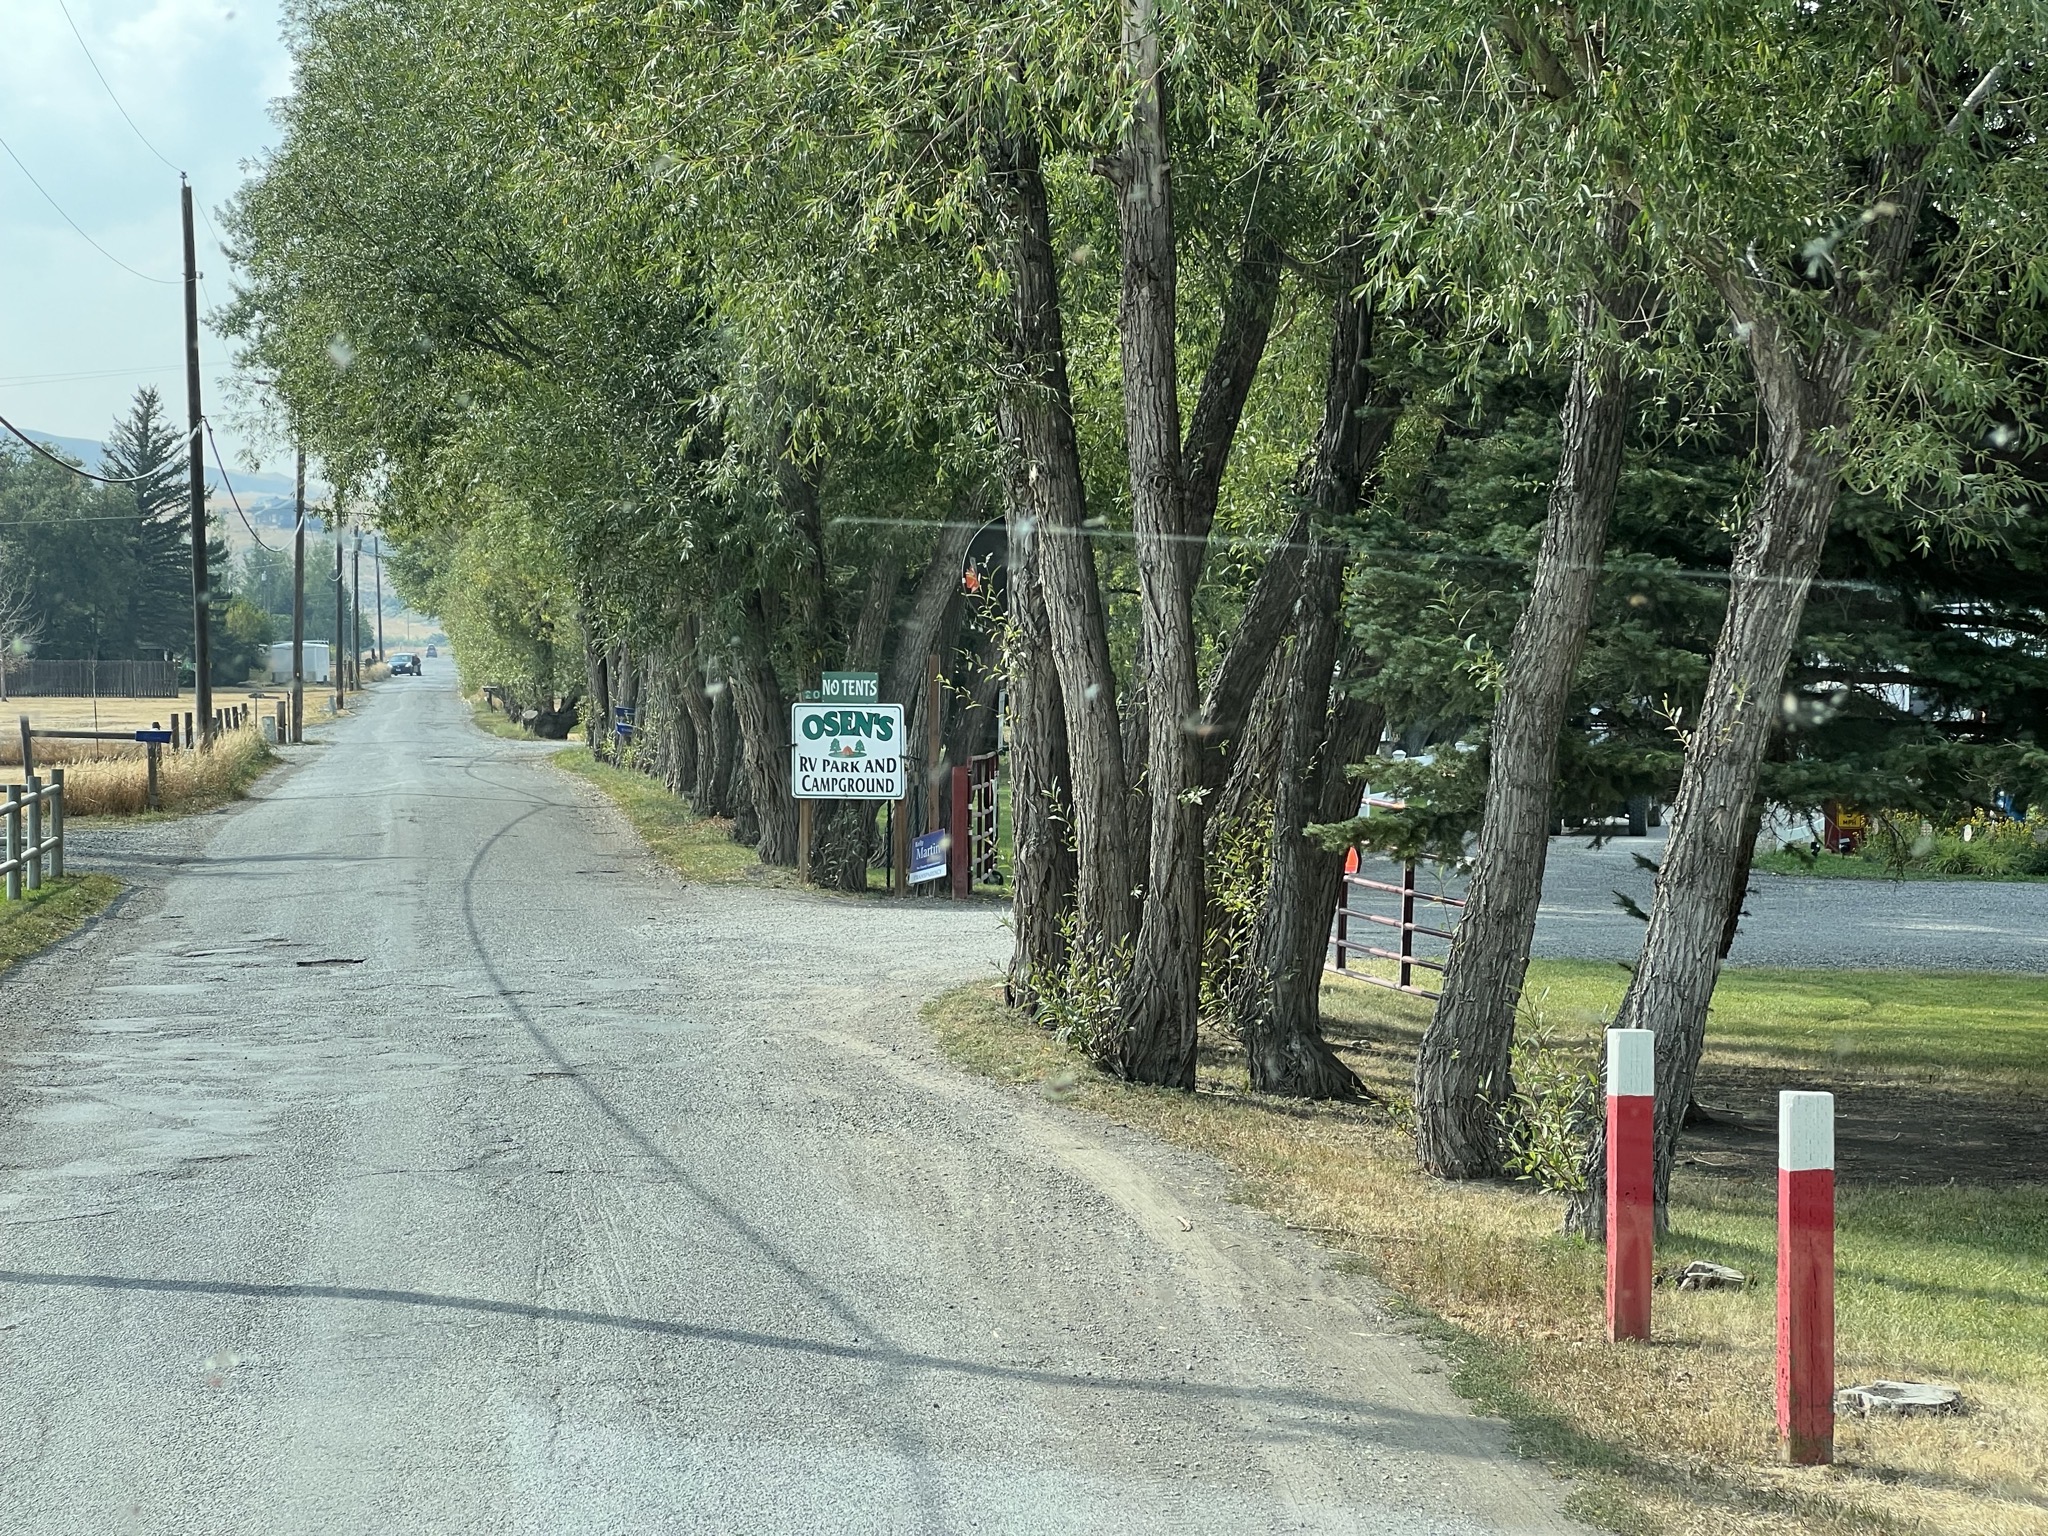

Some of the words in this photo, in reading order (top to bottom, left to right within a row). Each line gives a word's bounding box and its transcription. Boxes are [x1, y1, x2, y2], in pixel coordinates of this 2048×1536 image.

[822, 679, 840, 696] NO
[841, 679, 877, 697] TENTS
[802, 711, 894, 741] OSEN'S
[799, 756, 818, 772] RV
[822, 759, 860, 773] PARK
[864, 757, 897, 773] AND
[801, 774, 895, 793] CAMPGROUND
[916, 842, 941, 860] Martin
